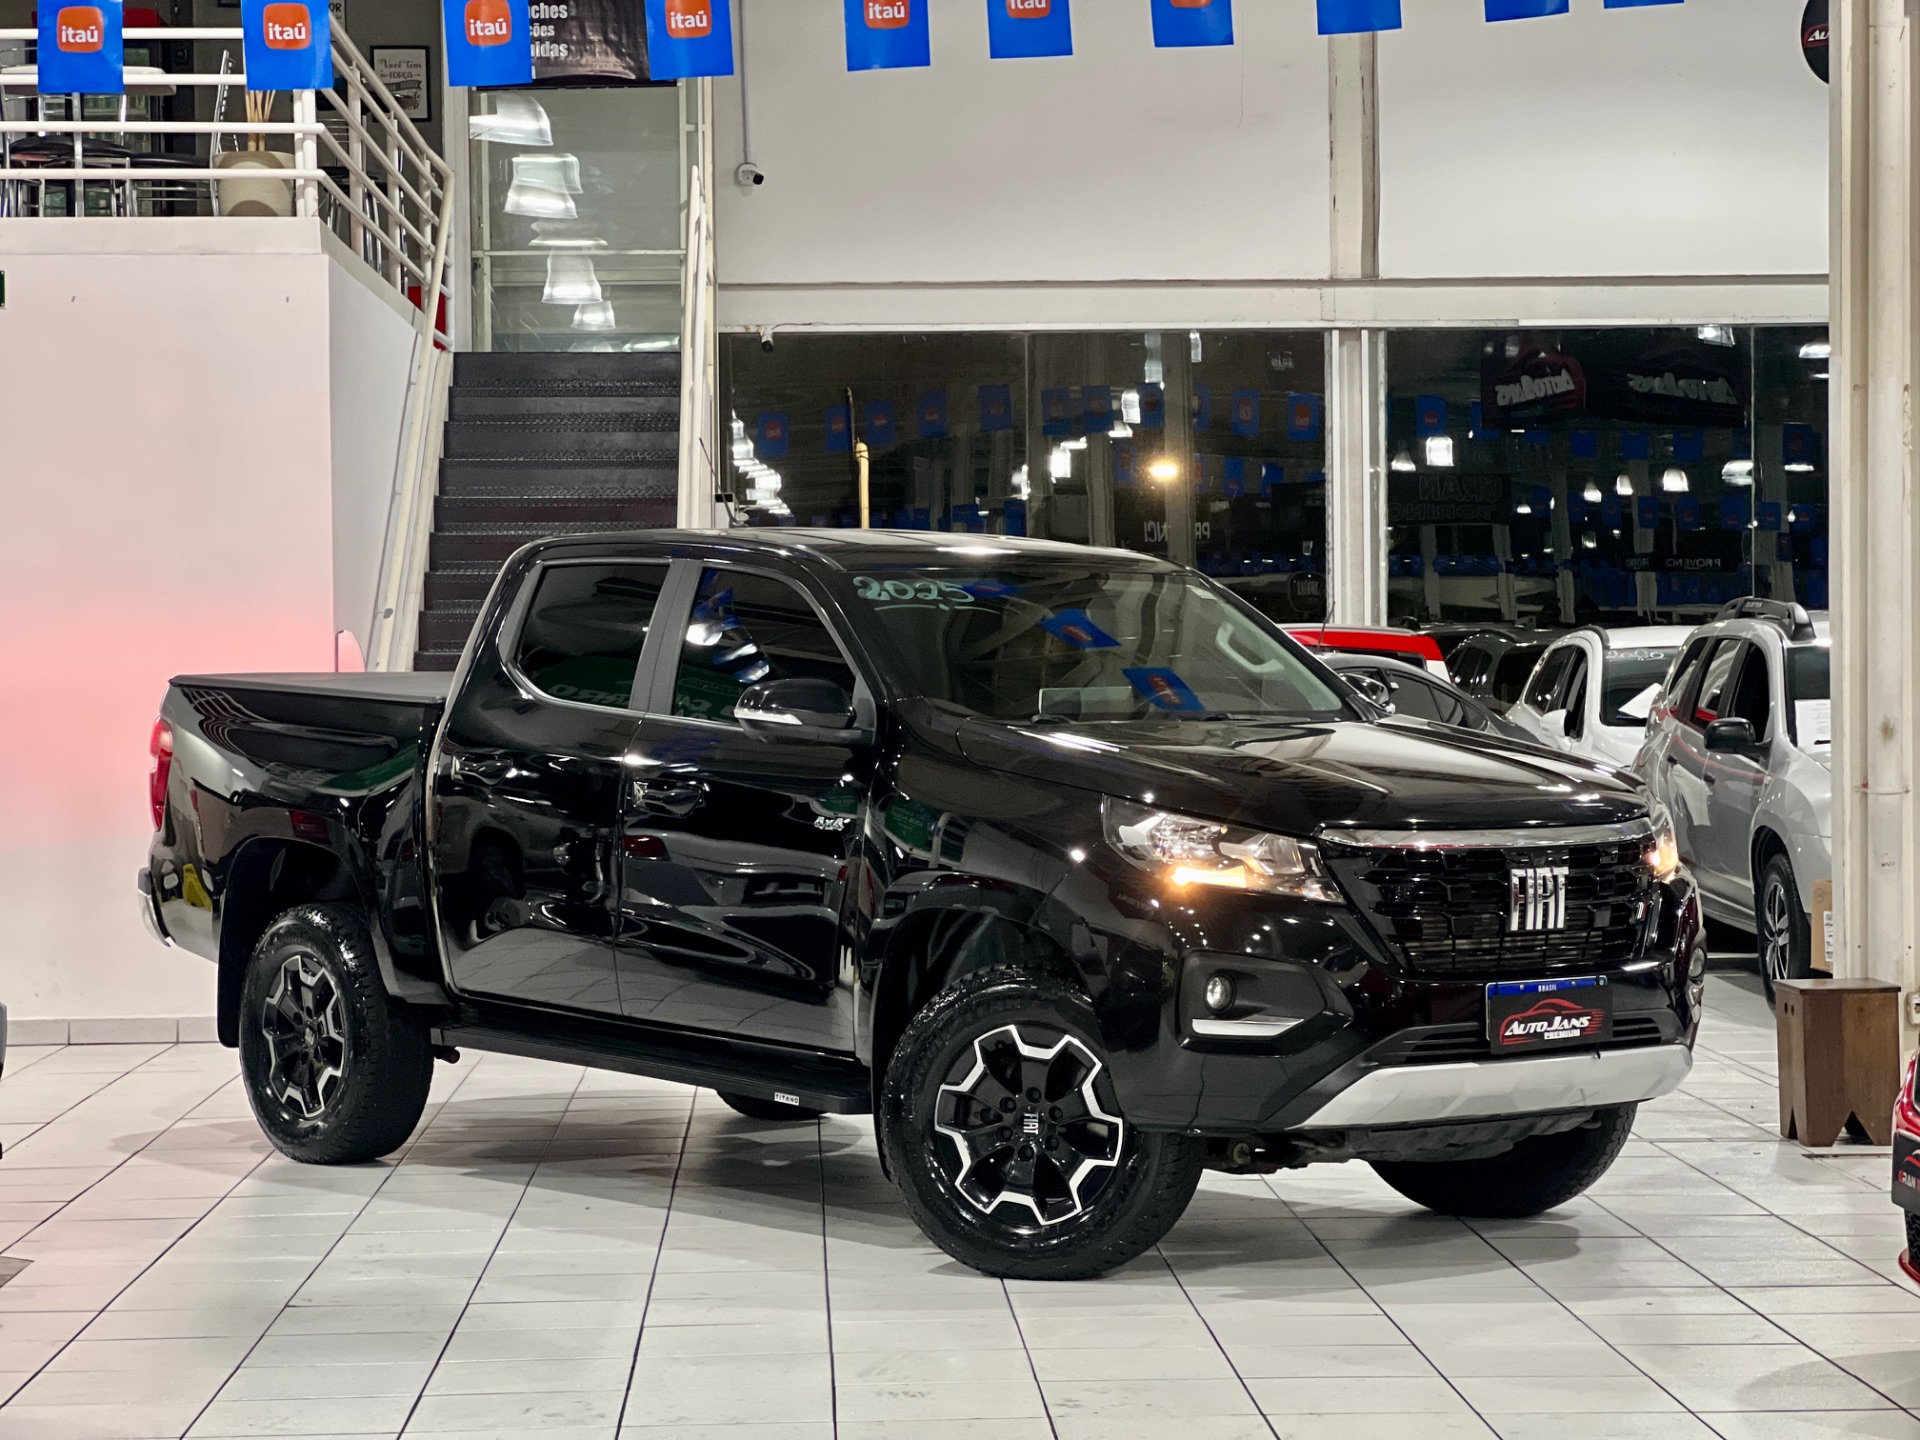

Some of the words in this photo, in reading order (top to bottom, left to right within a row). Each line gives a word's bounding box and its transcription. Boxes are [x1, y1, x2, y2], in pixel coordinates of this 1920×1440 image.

[529, 2, 568, 19] ches
[670, 10, 707, 29] itaú
[61, 25, 98, 43] itaú
[268, 22, 306, 40] itaú
[469, 17, 507, 36] itaú
[853, 576, 975, 603] 2025
[1510, 867, 1569, 931] FIAT
[1538, 984, 1558, 993] BRASIL
[1544, 1028, 1581, 1040] PREMIUM
[775, 1093, 799, 1105] TITANO
[1023, 1112, 1039, 1135] FIAT
